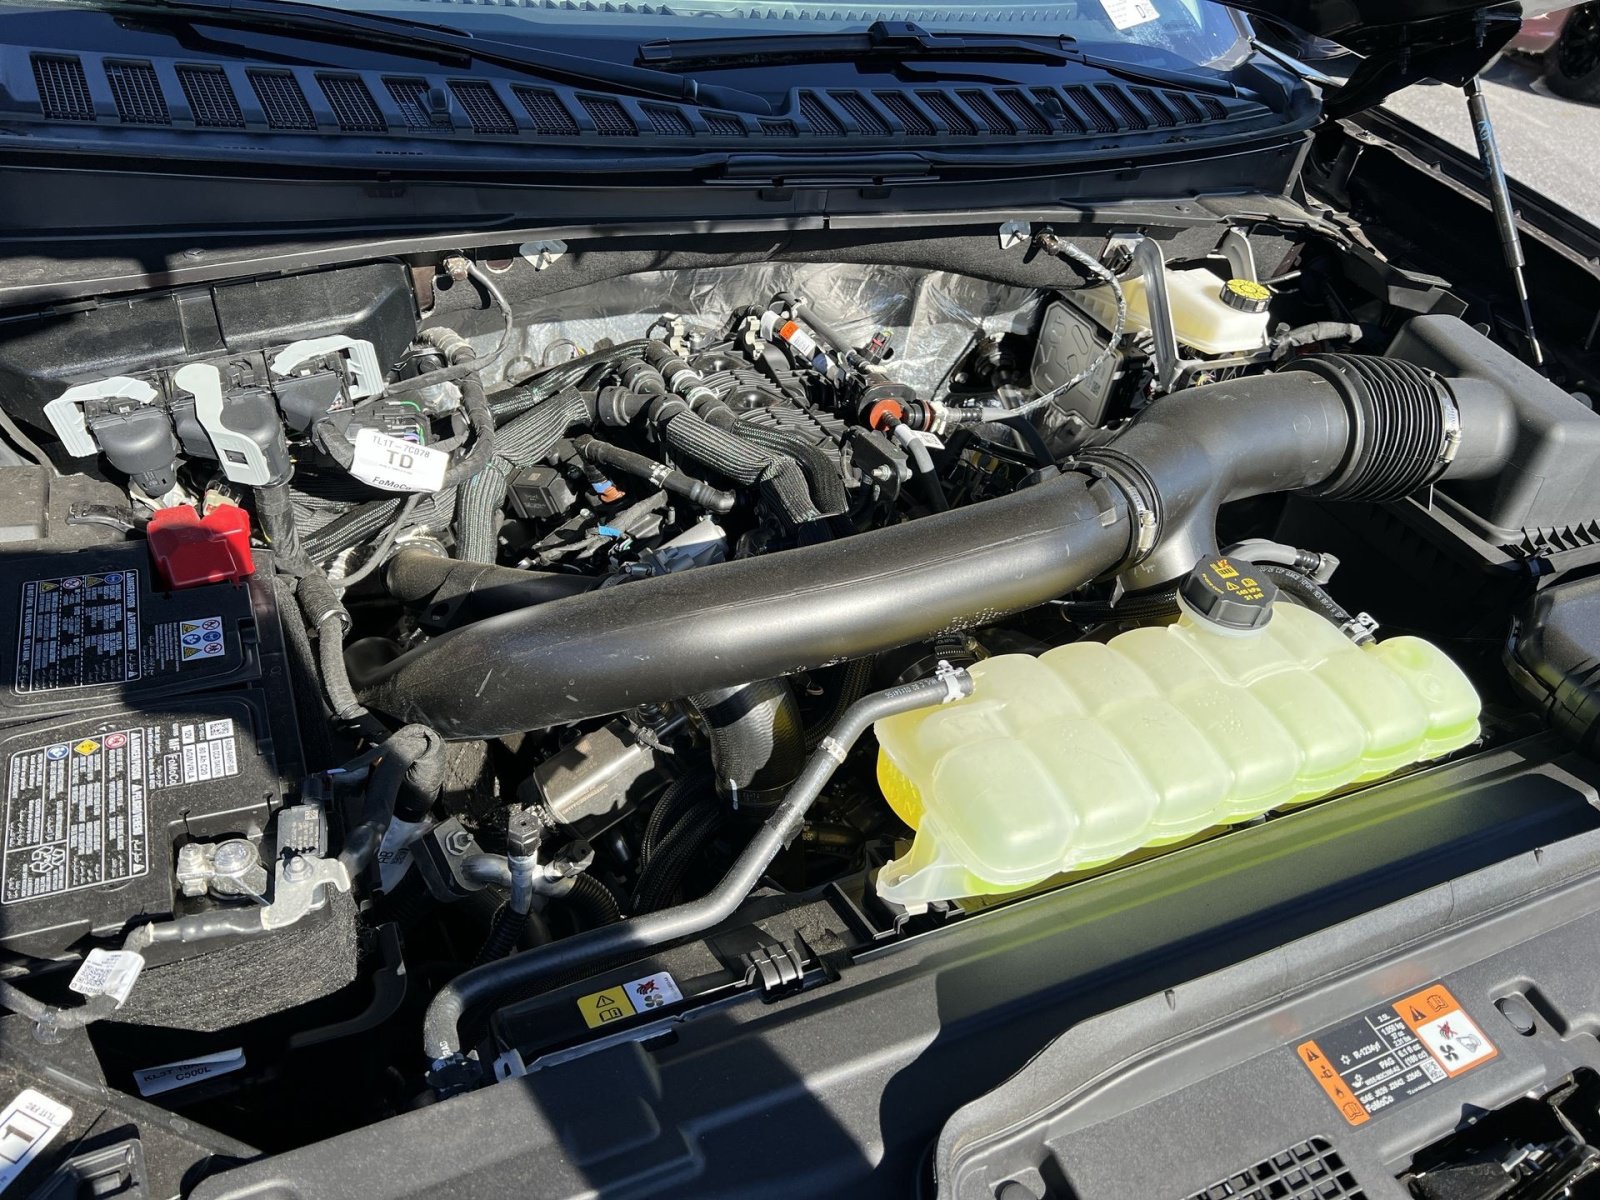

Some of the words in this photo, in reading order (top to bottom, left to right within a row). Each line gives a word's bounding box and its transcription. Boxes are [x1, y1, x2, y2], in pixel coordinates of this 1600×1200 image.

[386, 449, 414, 470] TD
[372, 476, 412, 491] FoMoCo
[183, 729, 192, 739] 12V
[183, 747, 197, 779] AGM/VRLA
[199, 754, 207, 763] Ah
[170, 755, 181, 784] FoMoCo
[199, 763, 209, 775] C20
[1395, 1021, 1405, 1031] kg
[1352, 1041, 1380, 1059] R-1234yf
[1417, 1051, 1428, 1060] cc)
[1379, 1057, 1395, 1069] PAG
[1359, 1093, 1373, 1103] SAE
[1365, 1094, 1394, 1113] FoMoCo
